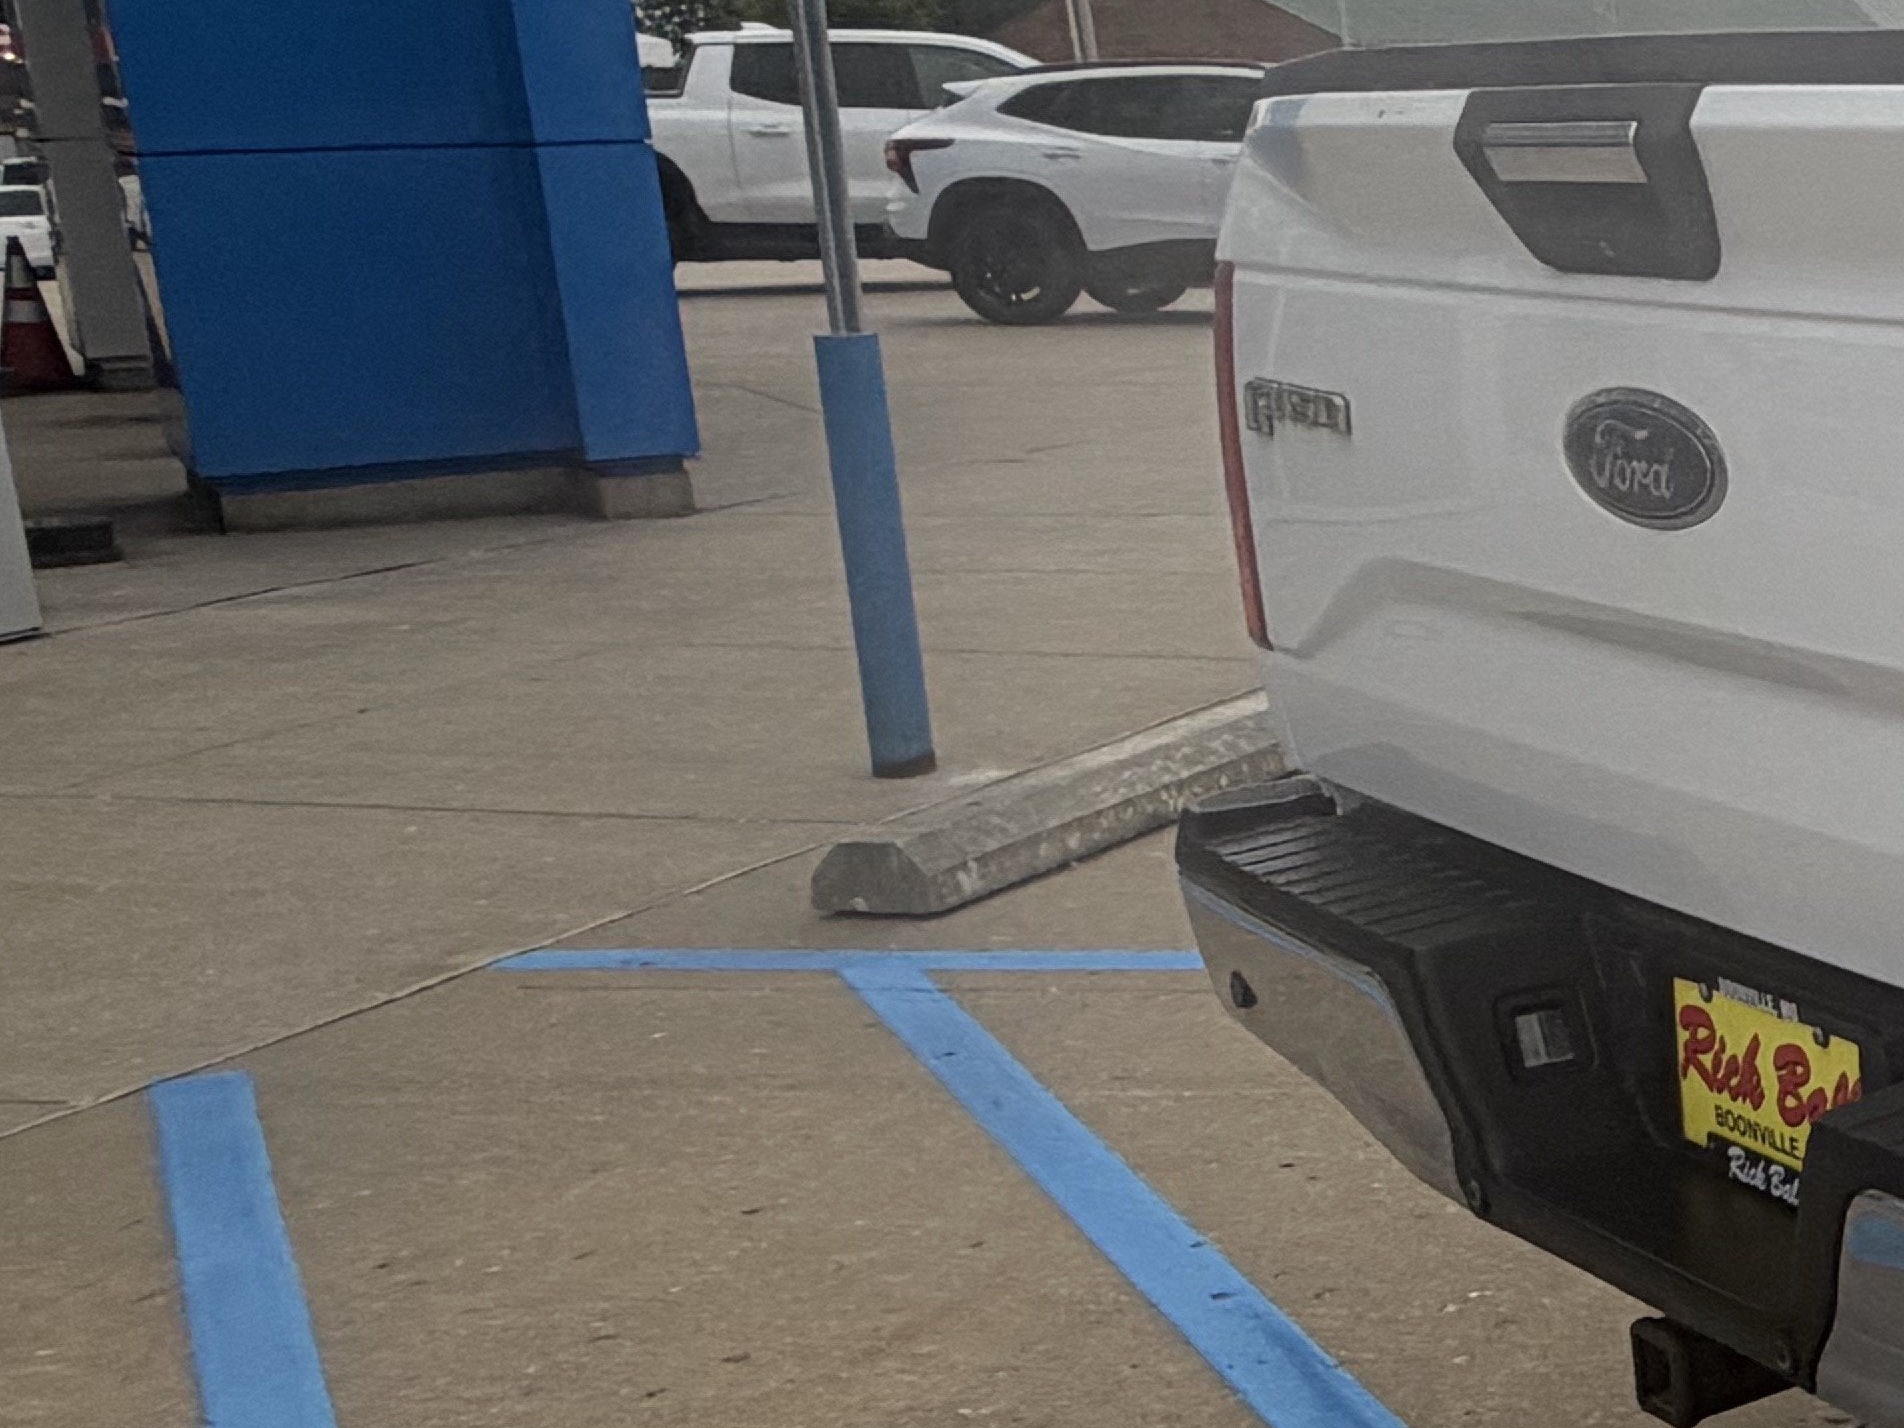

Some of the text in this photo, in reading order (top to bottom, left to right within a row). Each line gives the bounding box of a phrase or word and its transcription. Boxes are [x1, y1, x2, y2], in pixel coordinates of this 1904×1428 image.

[1588, 418, 1675, 500] Ford
[1679, 1005, 1766, 1112] Rick
[1714, 1104, 1800, 1157] BOONVILLE
[1727, 1146, 1767, 1191] Rick
